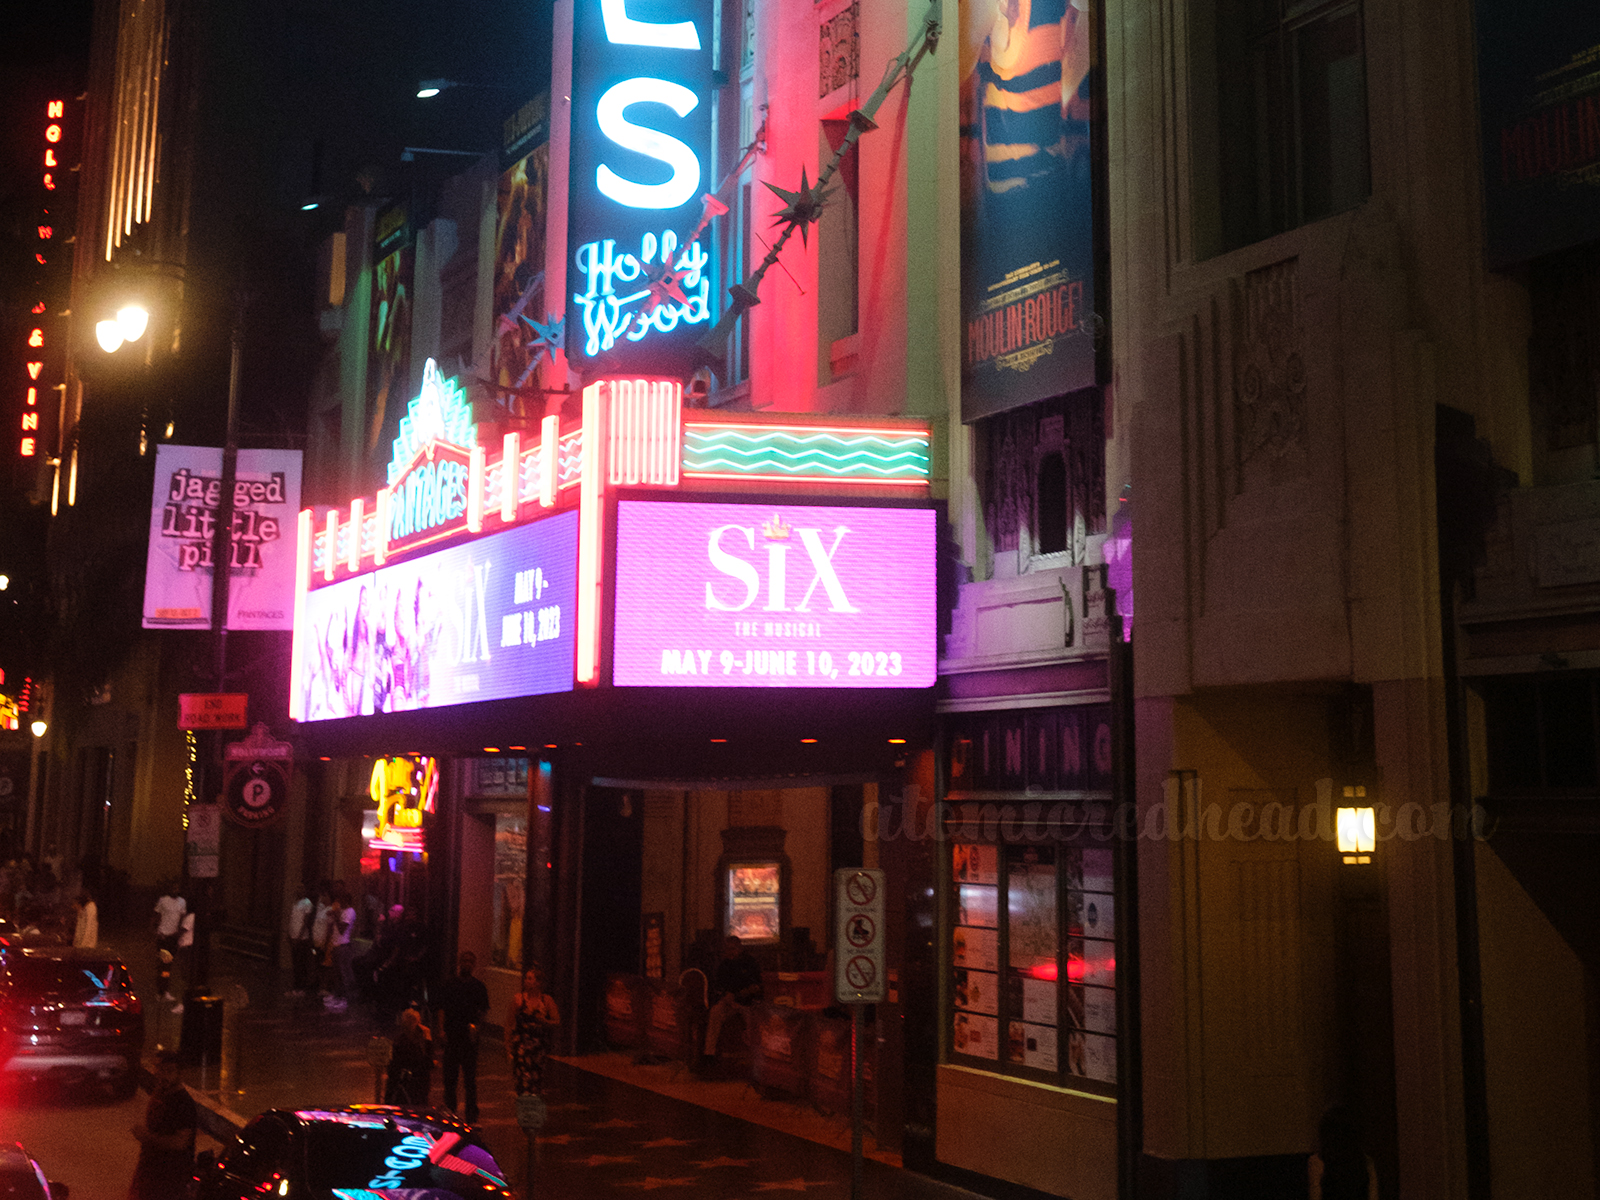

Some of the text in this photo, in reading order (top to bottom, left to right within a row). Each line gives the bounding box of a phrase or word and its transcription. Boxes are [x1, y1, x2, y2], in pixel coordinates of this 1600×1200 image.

[28, 328, 44, 347] &
[968, 302, 1022, 362] MOULIN
[20, 361, 44, 456] VINE
[171, 470, 283, 506] jagged
[162, 506, 277, 541] little
[179, 542, 259, 571] pill
[705, 524, 860, 613] SIX
[735, 622, 821, 637] THE MUSICAL
[661, 649, 903, 680] MAY 9-JUNE 10, 2023
[253, 783, 264, 803] P
